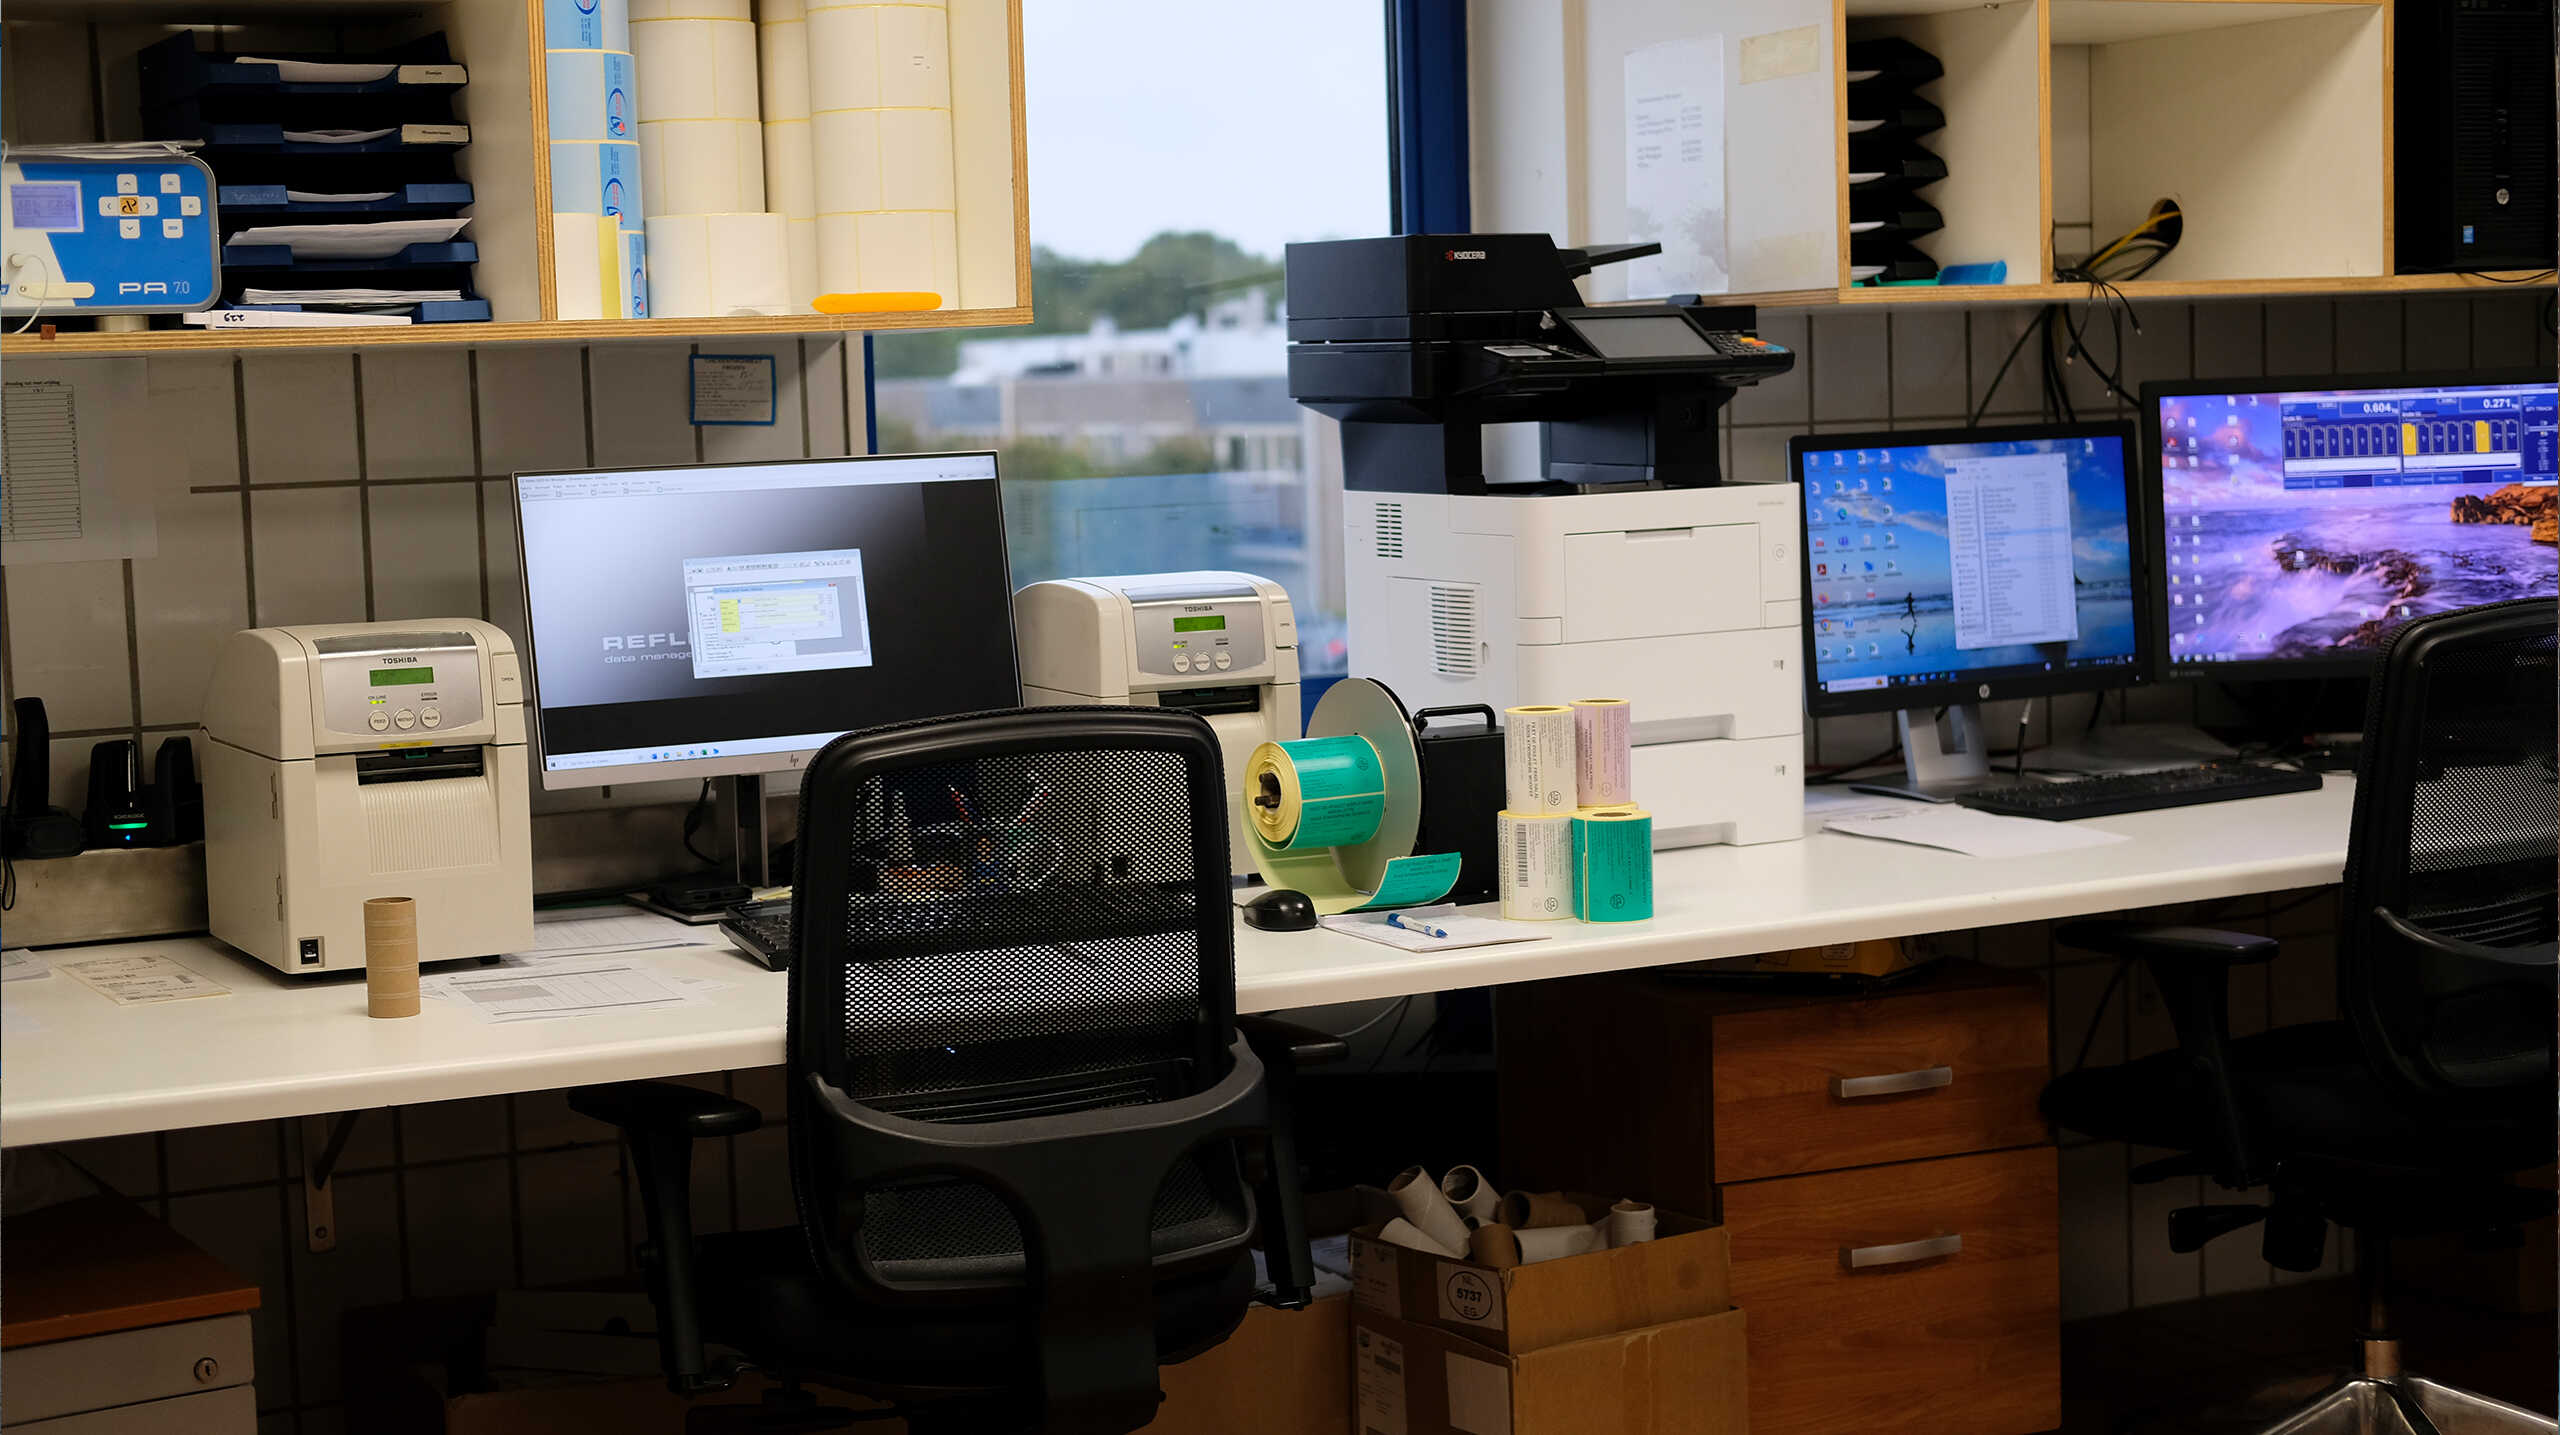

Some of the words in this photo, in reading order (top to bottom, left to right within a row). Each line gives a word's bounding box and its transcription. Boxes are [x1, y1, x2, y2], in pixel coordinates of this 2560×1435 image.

[1453, 250, 1486, 260] KYOCERA
[119, 282, 167, 294] PA
[602, 632, 692, 651] REFL
[382, 656, 418, 664] TOSHIBA
[1457, 1287, 1482, 1302] 5737
